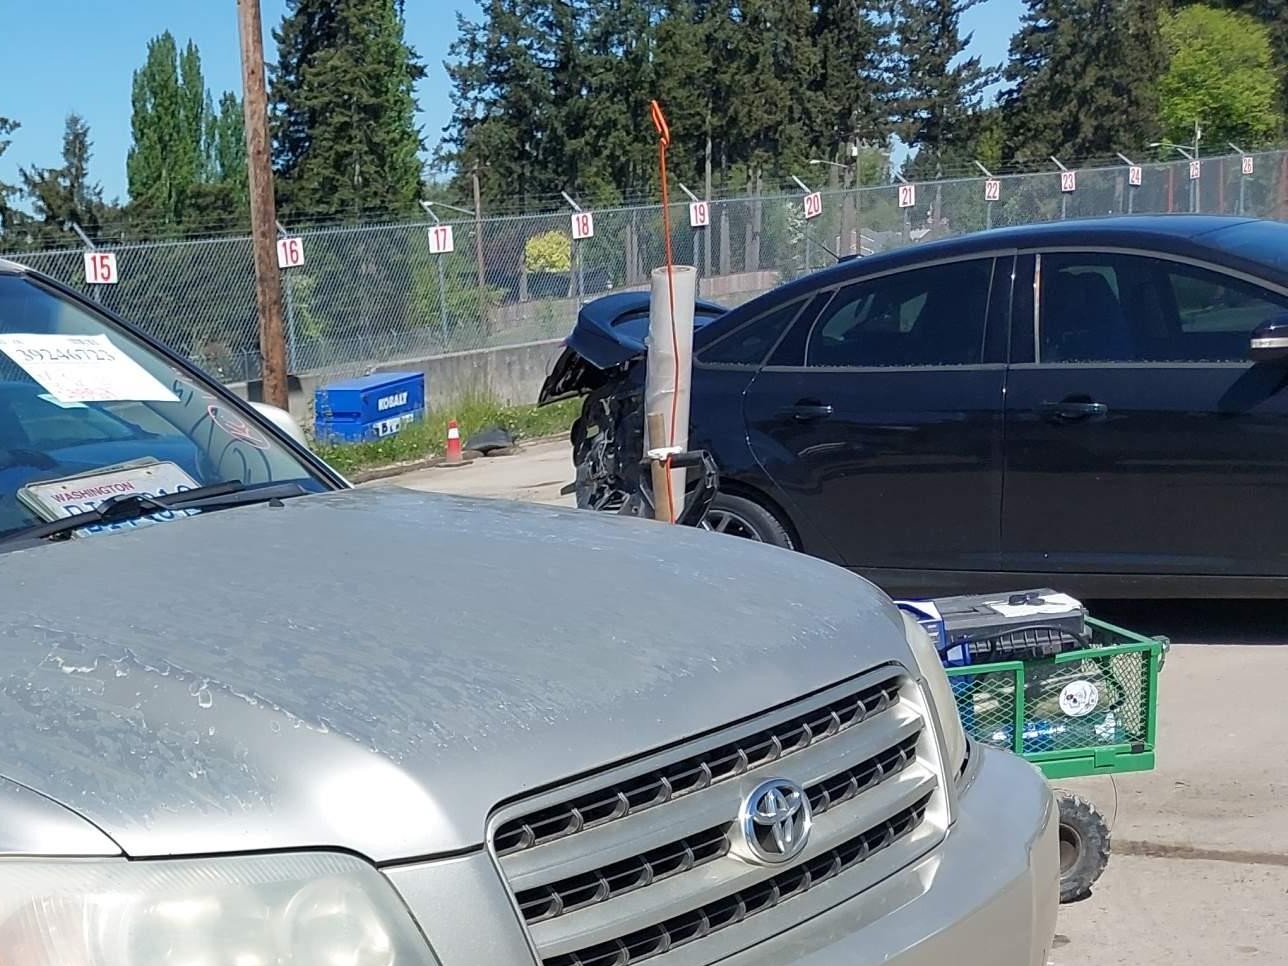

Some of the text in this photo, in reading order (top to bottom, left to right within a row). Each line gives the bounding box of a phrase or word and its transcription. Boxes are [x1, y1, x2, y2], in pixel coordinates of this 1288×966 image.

[1131, 168, 1140, 183] 24
[1243, 158, 1252, 173] 26
[987, 182, 998, 199] 22
[1063, 174, 1074, 189] 23
[806, 194, 820, 215] 20
[902, 187, 912, 205] 21
[694, 204, 705, 224] 19
[575, 215, 590, 236] 18
[434, 228, 447, 251] 17
[282, 240, 300, 265] 16
[91, 254, 111, 281] 15
[15, 349, 116, 362] 39246723
[378, 391, 408, 412] KOBALT
[50, 481, 136, 503] WASHINGTON
